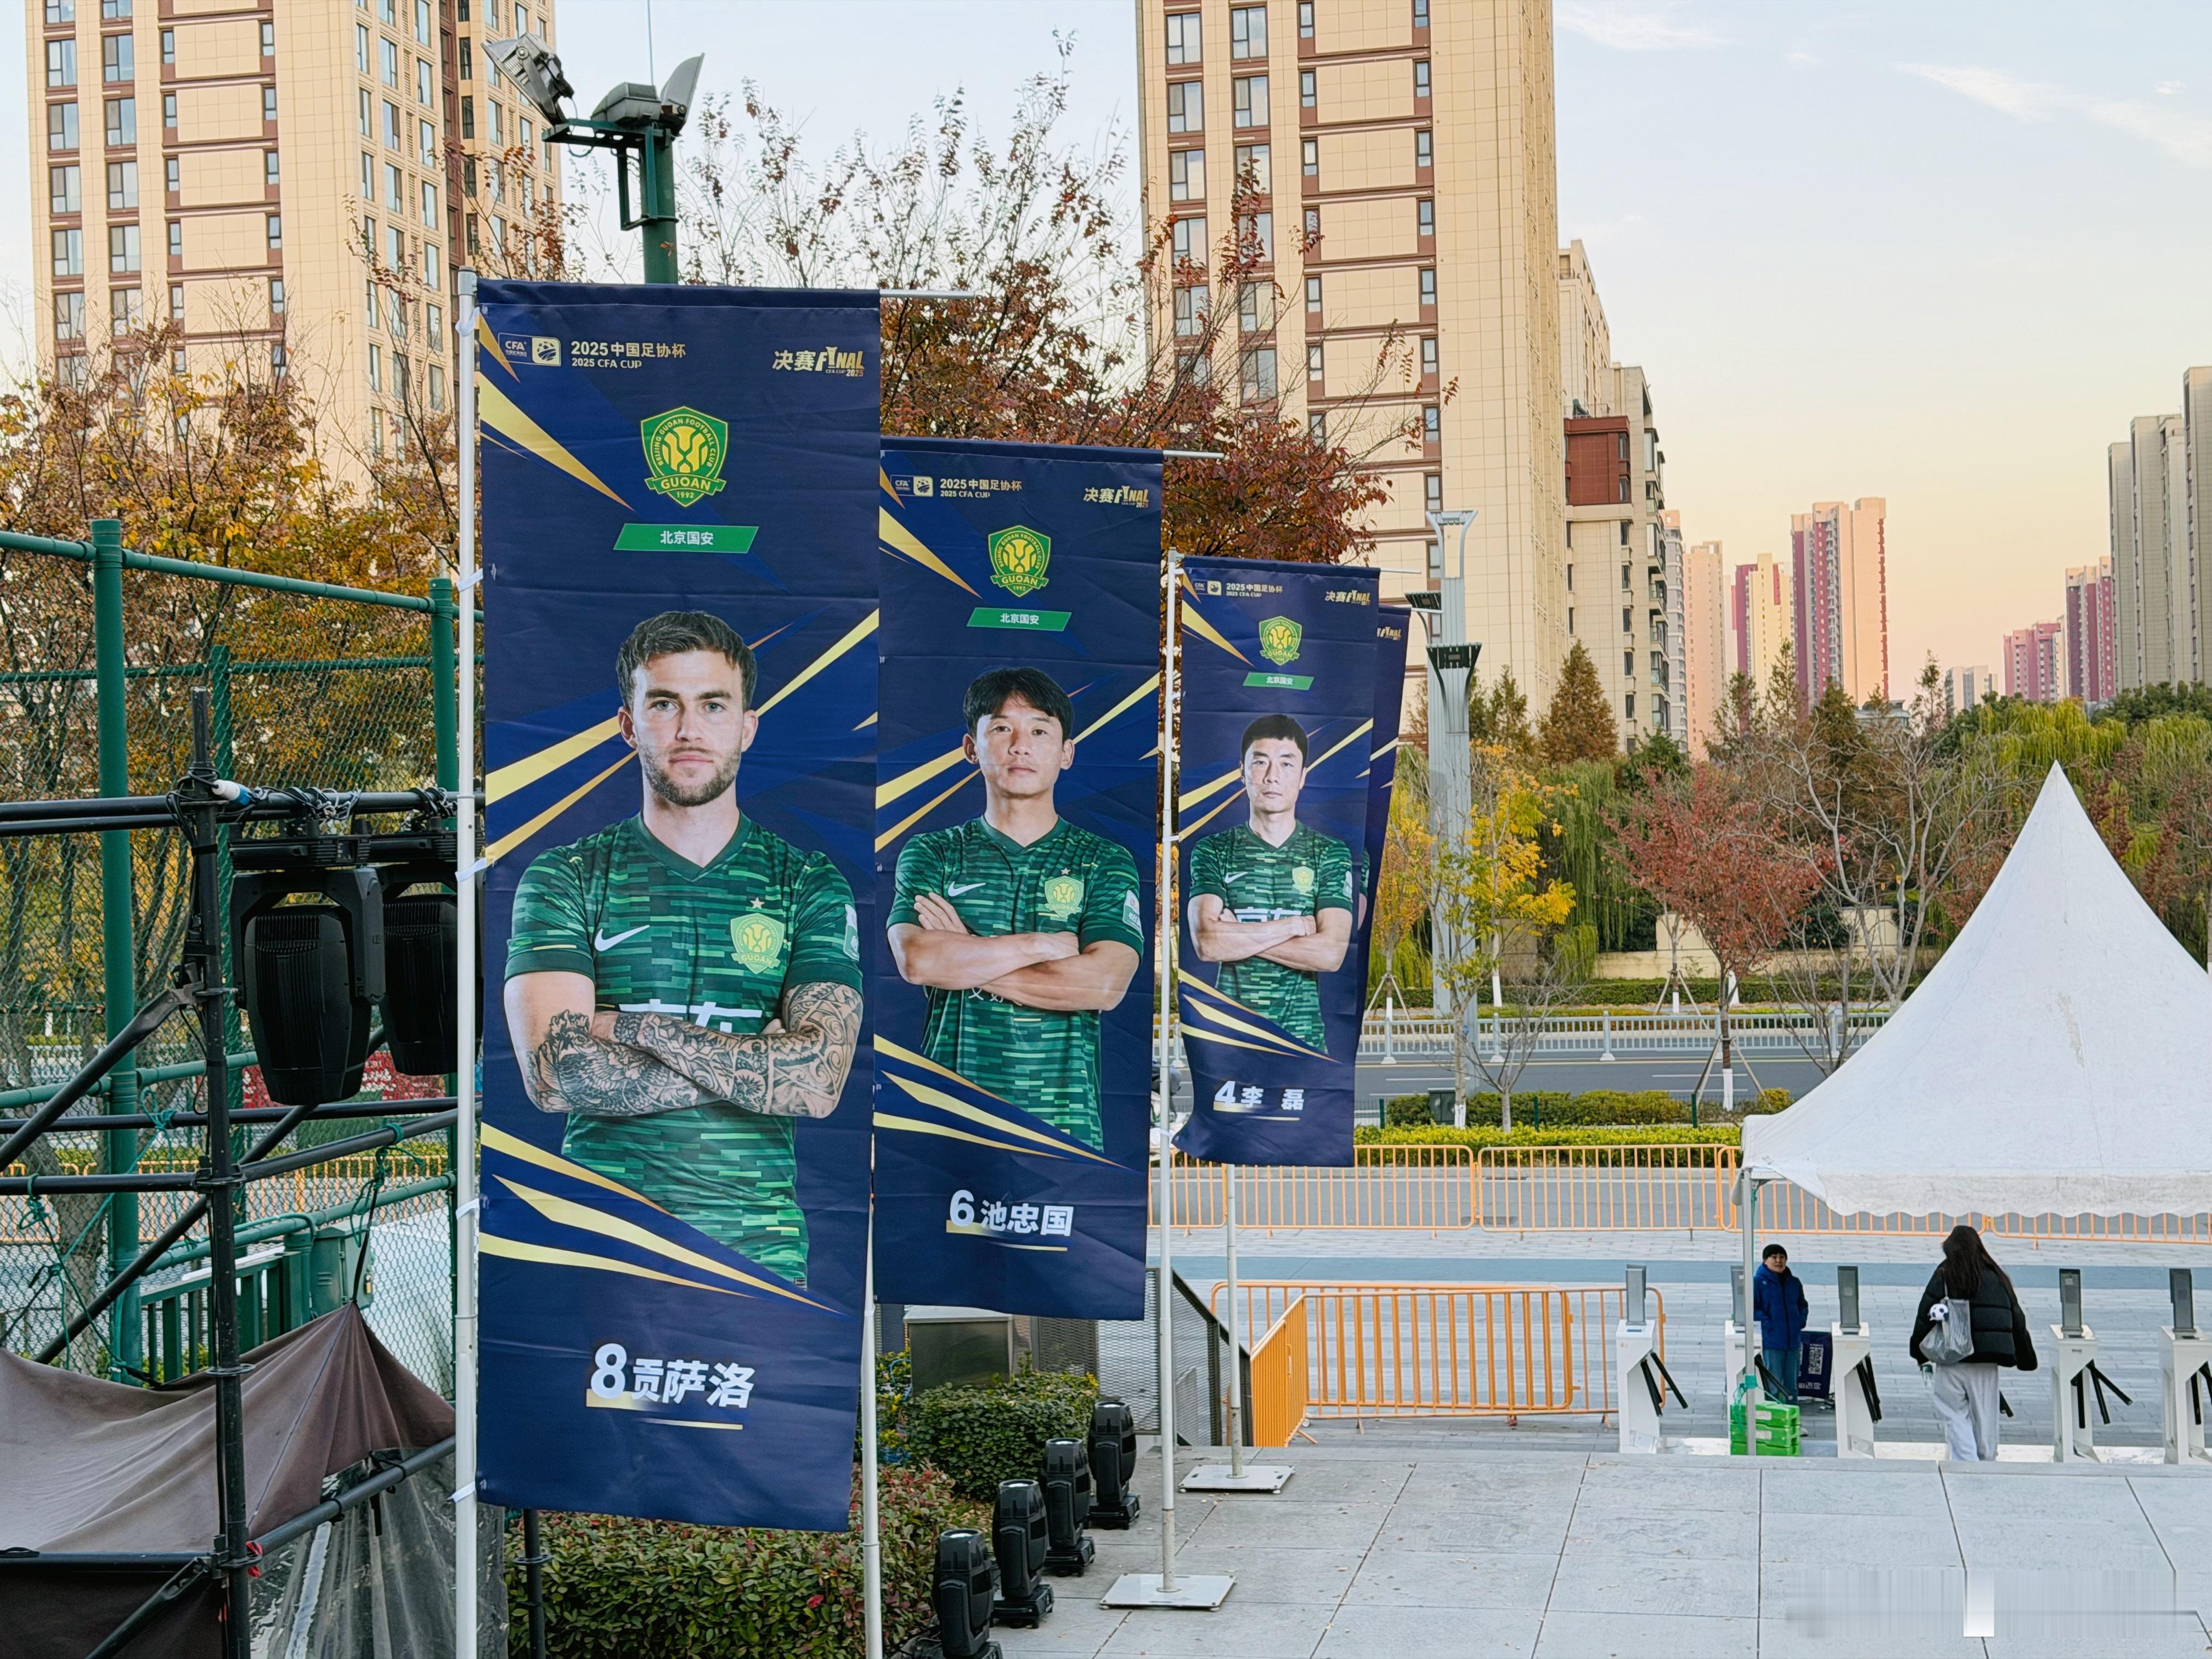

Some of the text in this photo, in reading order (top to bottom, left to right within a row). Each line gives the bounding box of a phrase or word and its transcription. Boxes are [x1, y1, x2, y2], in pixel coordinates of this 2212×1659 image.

[505, 341, 525, 351] CFA
[571, 341, 686, 358] 2025中国足协杯
[572, 358, 642, 369] 2025 CFA CUP
[772, 347, 865, 371] 决赛 FINAL
[653, 418, 716, 467] BEIJING GUOAN FOOTBALL CLUB
[661, 477, 711, 490] GUOAN
[1083, 485, 1149, 504] 决赛 FINAL
[660, 531, 713, 545] 北京国安
[1001, 533, 1019, 545] GUOAN
[1001, 575, 1038, 586] GUOAN
[1000, 613, 1039, 625] 北京国安
[741, 955, 772, 966] GUOAN
[1214, 1080, 1235, 1107] 4
[950, 1189, 1074, 1237] 6 池忠国
[591, 1343, 755, 1408] 8 贡萨洛
